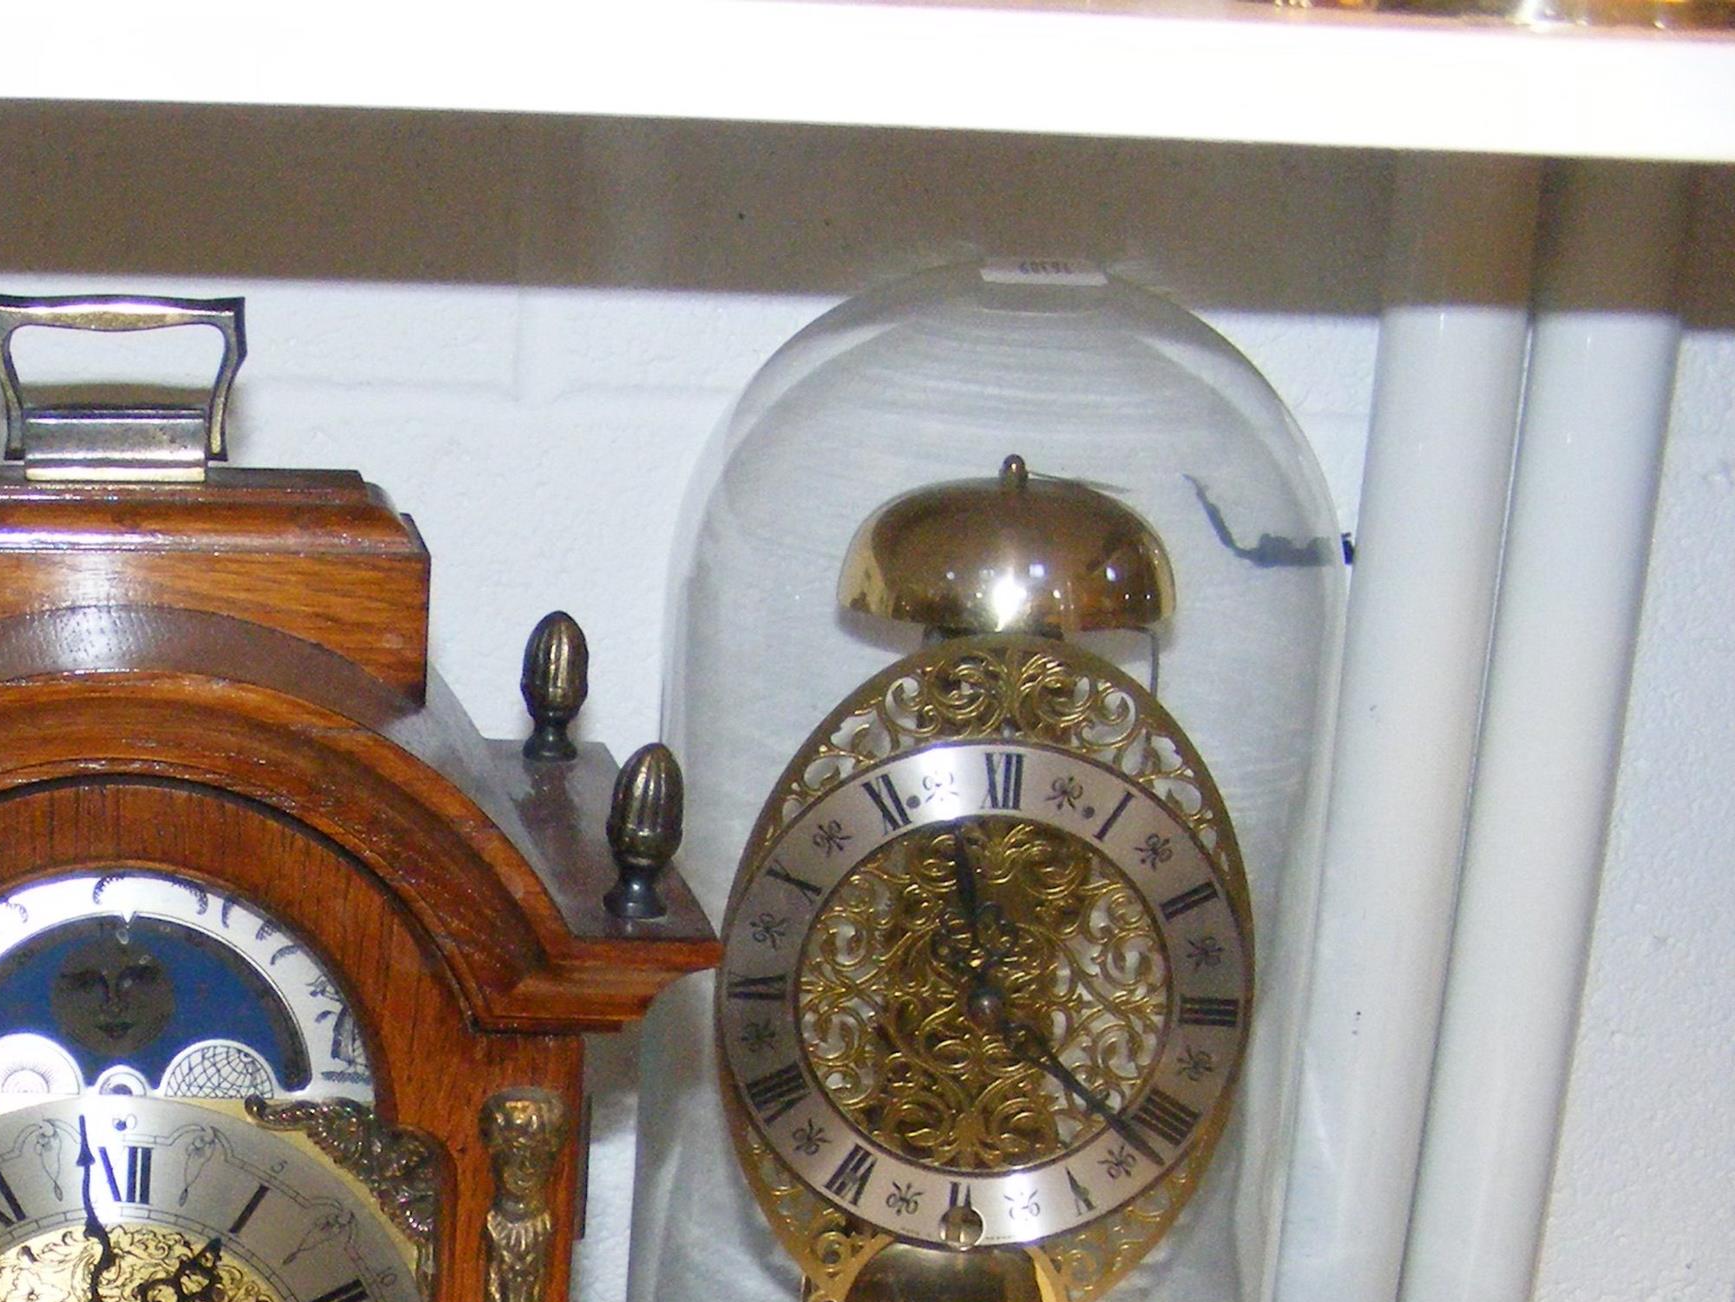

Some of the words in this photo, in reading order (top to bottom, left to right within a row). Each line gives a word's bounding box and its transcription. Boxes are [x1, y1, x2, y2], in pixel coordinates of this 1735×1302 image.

[981, 752, 1024, 811] XII
[862, 774, 913, 836] XI
[767, 859, 822, 904] X
[1160, 881, 1219, 921] II
[1179, 996, 1239, 1028] III
